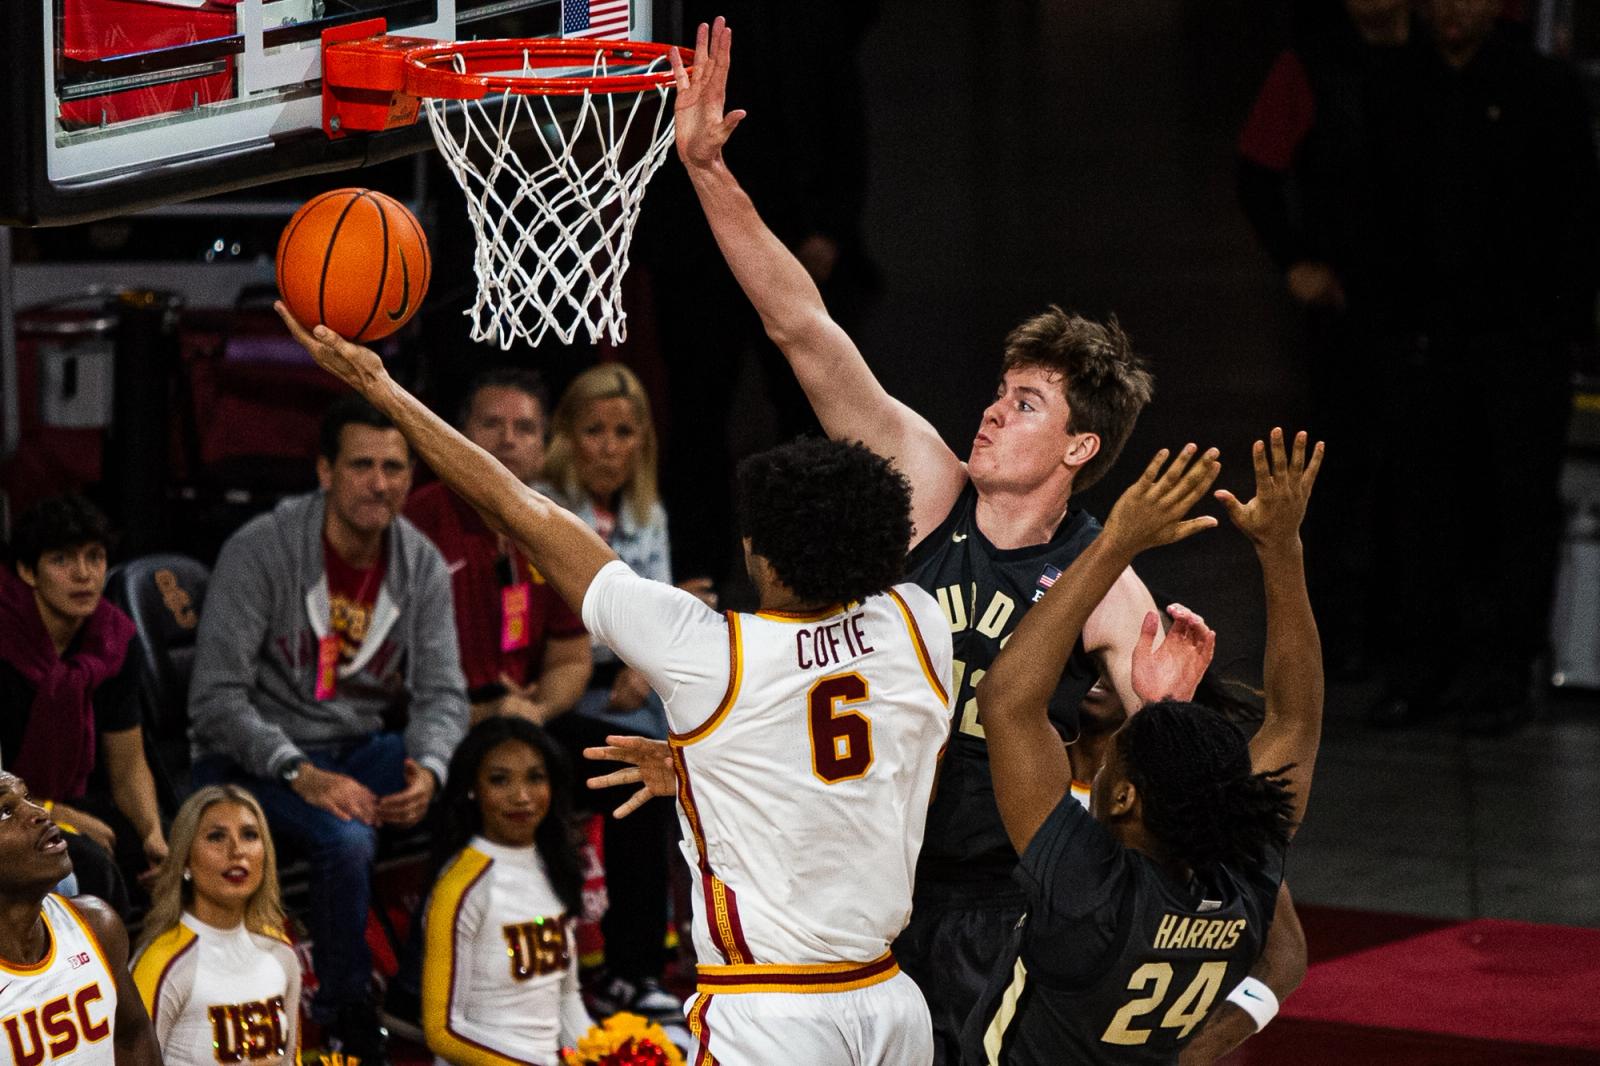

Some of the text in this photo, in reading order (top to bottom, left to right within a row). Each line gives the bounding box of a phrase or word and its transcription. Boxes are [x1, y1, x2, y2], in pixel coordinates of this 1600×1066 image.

[796, 612, 875, 669] COFIE
[806, 671, 875, 785] 6
[1153, 914, 1247, 949] HARRIS
[0, 980, 111, 1066] USC
[207, 995, 290, 1064] USC
[1100, 961, 1228, 1046] 24
